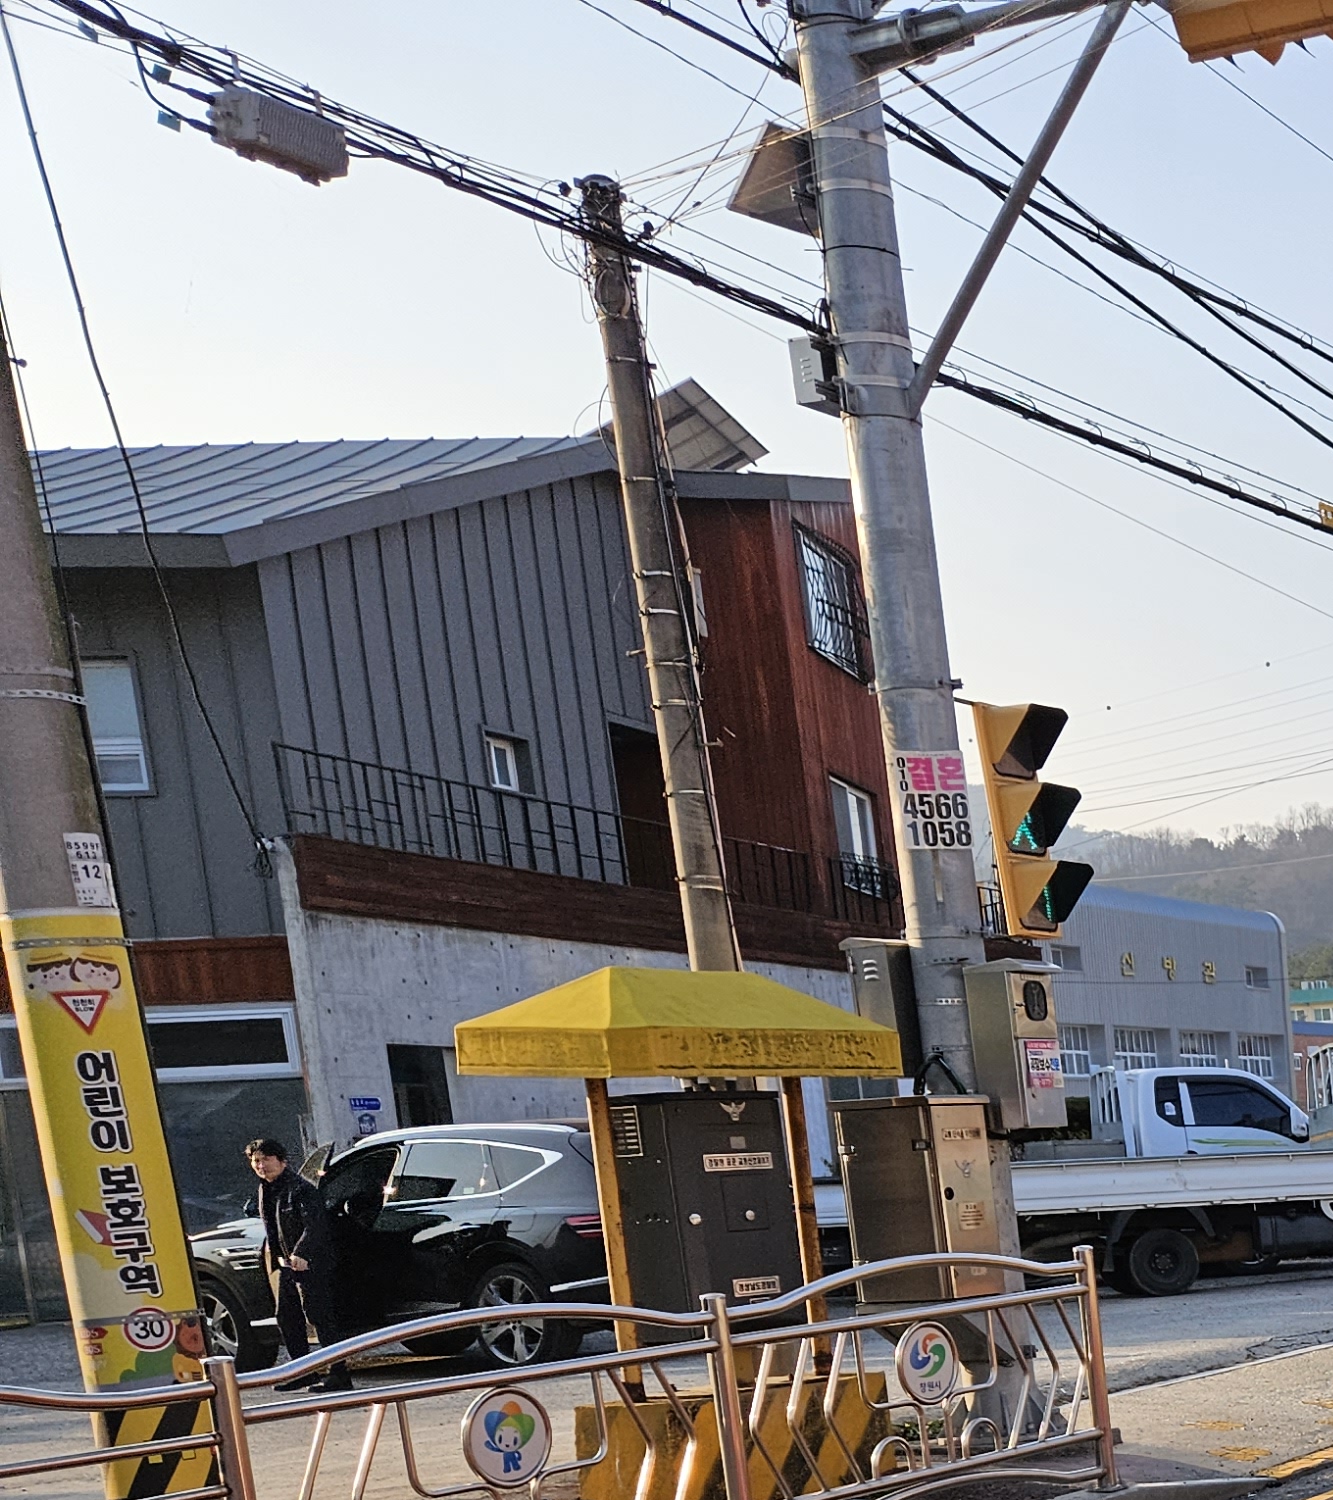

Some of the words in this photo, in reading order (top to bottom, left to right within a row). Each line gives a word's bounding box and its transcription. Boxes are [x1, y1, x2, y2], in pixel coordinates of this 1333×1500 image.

[896, 757, 909, 791] 010
[906, 757, 965, 791] 결혼
[903, 793, 968, 819] 4566
[906, 821, 972, 847] 1058
[81, 864, 102, 879] 12
[1121, 951, 1217, 984] 신방관
[76, 1051, 133, 1151] 어린이
[98, 1164, 163, 1297] 보호구역
[134, 1319, 165, 1340] 30
[920, 1381, 942, 1393] 창원시
